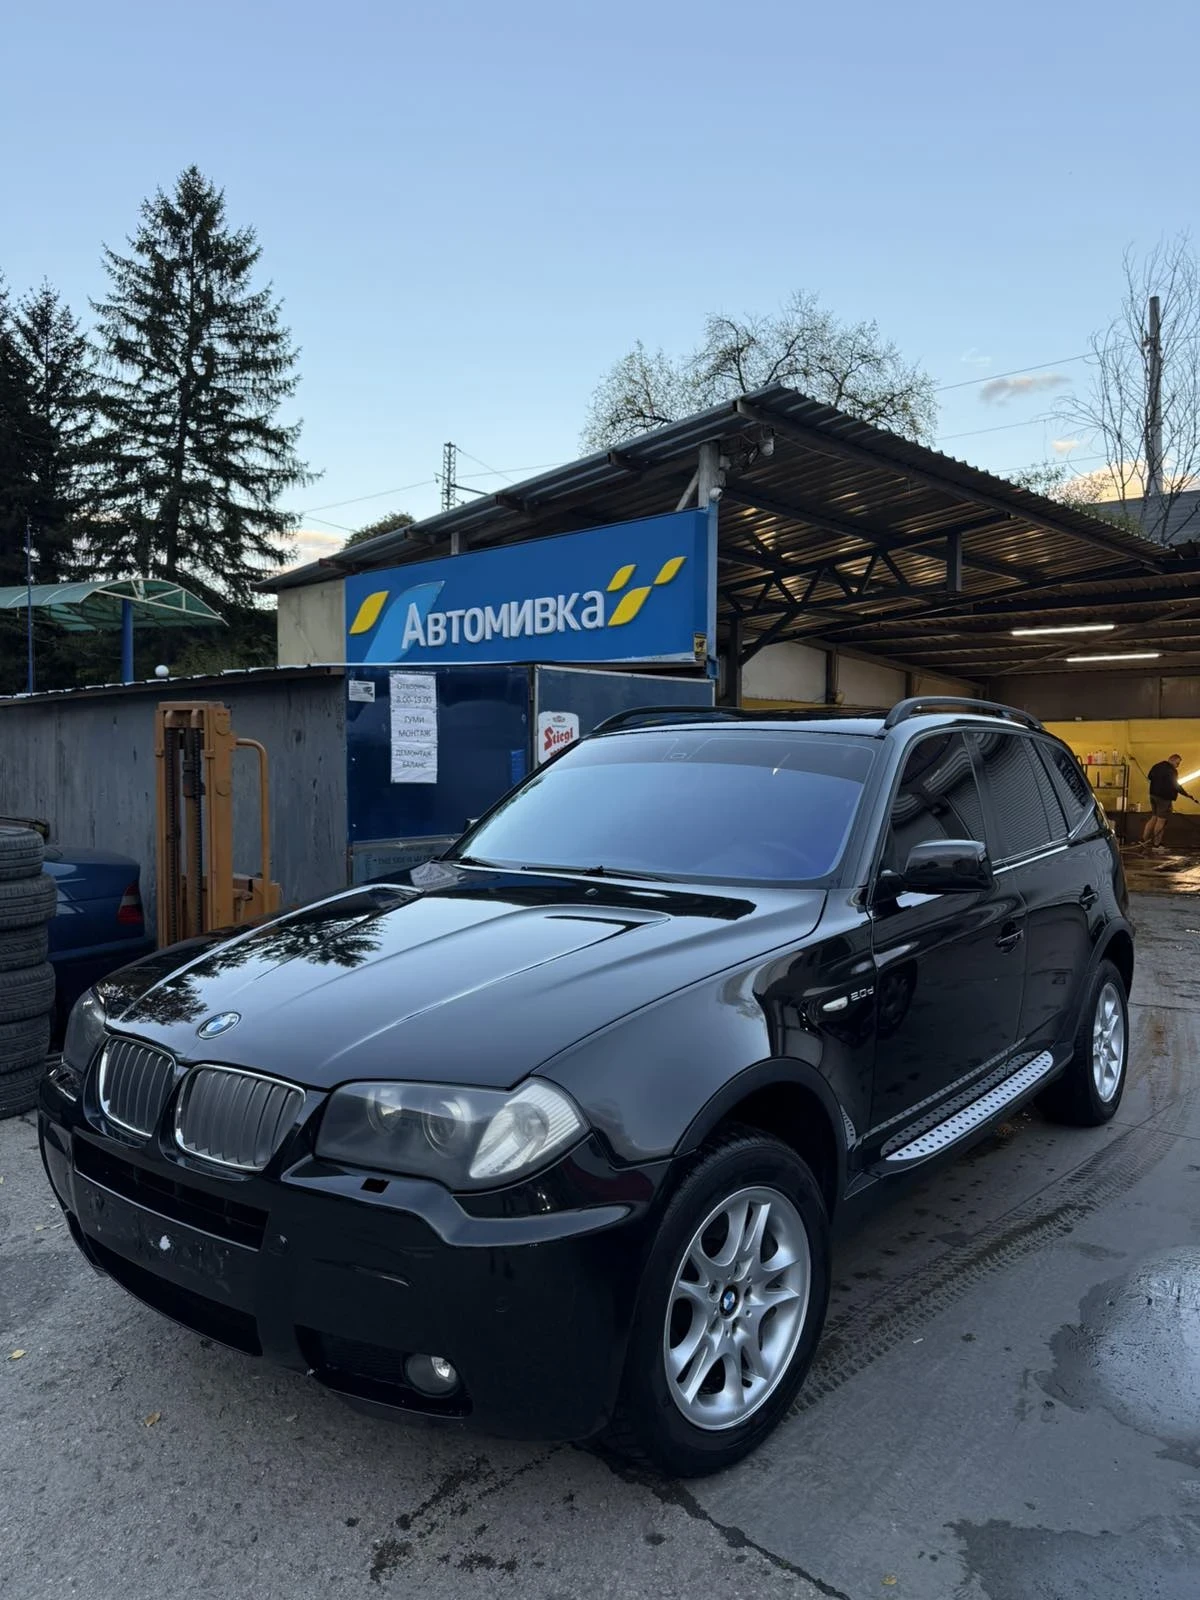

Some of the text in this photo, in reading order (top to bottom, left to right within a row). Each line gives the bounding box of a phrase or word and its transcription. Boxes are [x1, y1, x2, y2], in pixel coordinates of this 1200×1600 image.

[401, 590, 605, 649] Автомивка
[403, 715, 425, 725] ГУМИ
[398, 729, 432, 738] МОНТАЖ
[402, 760, 427, 769] БАЛАНС
